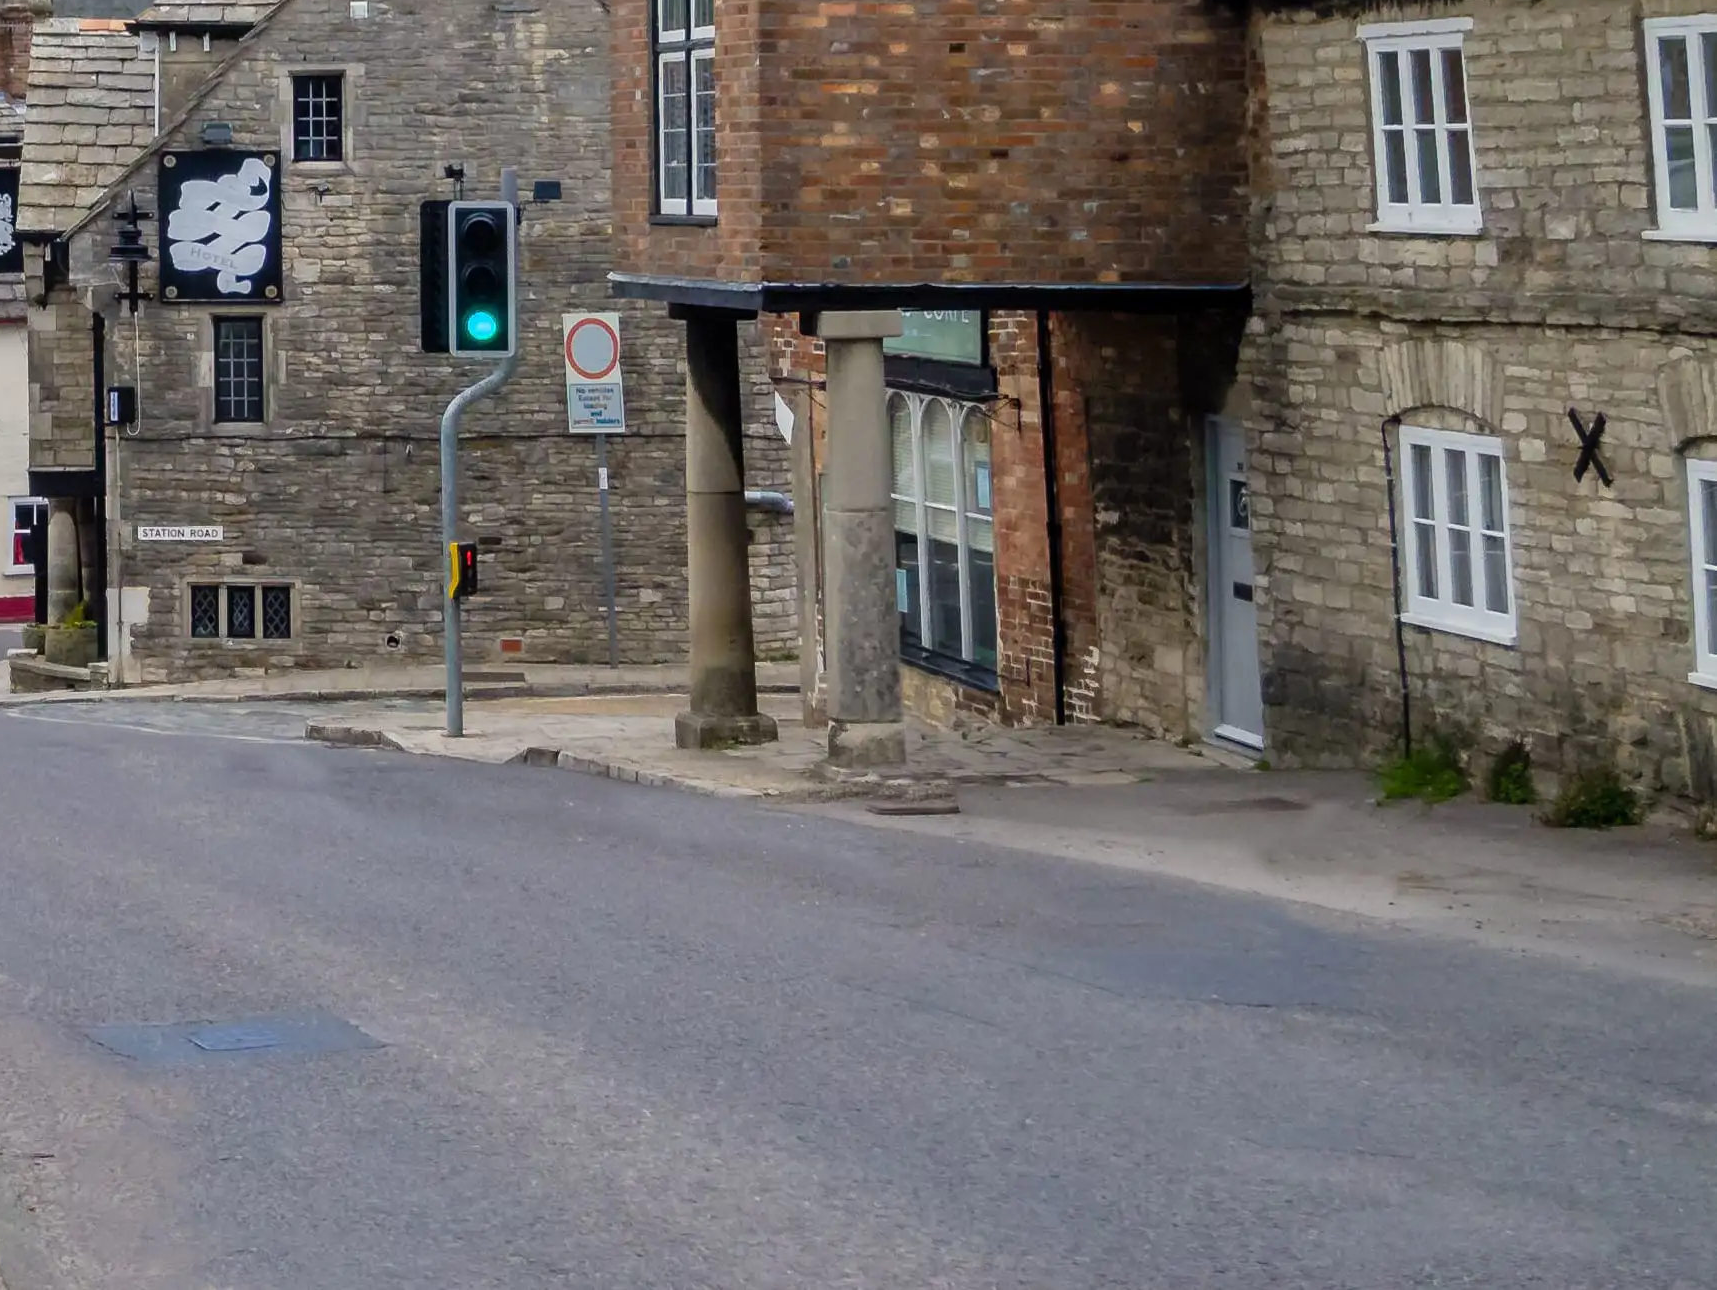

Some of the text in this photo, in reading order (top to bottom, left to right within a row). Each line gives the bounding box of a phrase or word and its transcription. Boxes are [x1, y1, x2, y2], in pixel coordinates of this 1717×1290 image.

[190, 246, 238, 270] HOTEL
[576, 386, 586, 395] No
[142, 528, 219, 539] STATION ROAD
